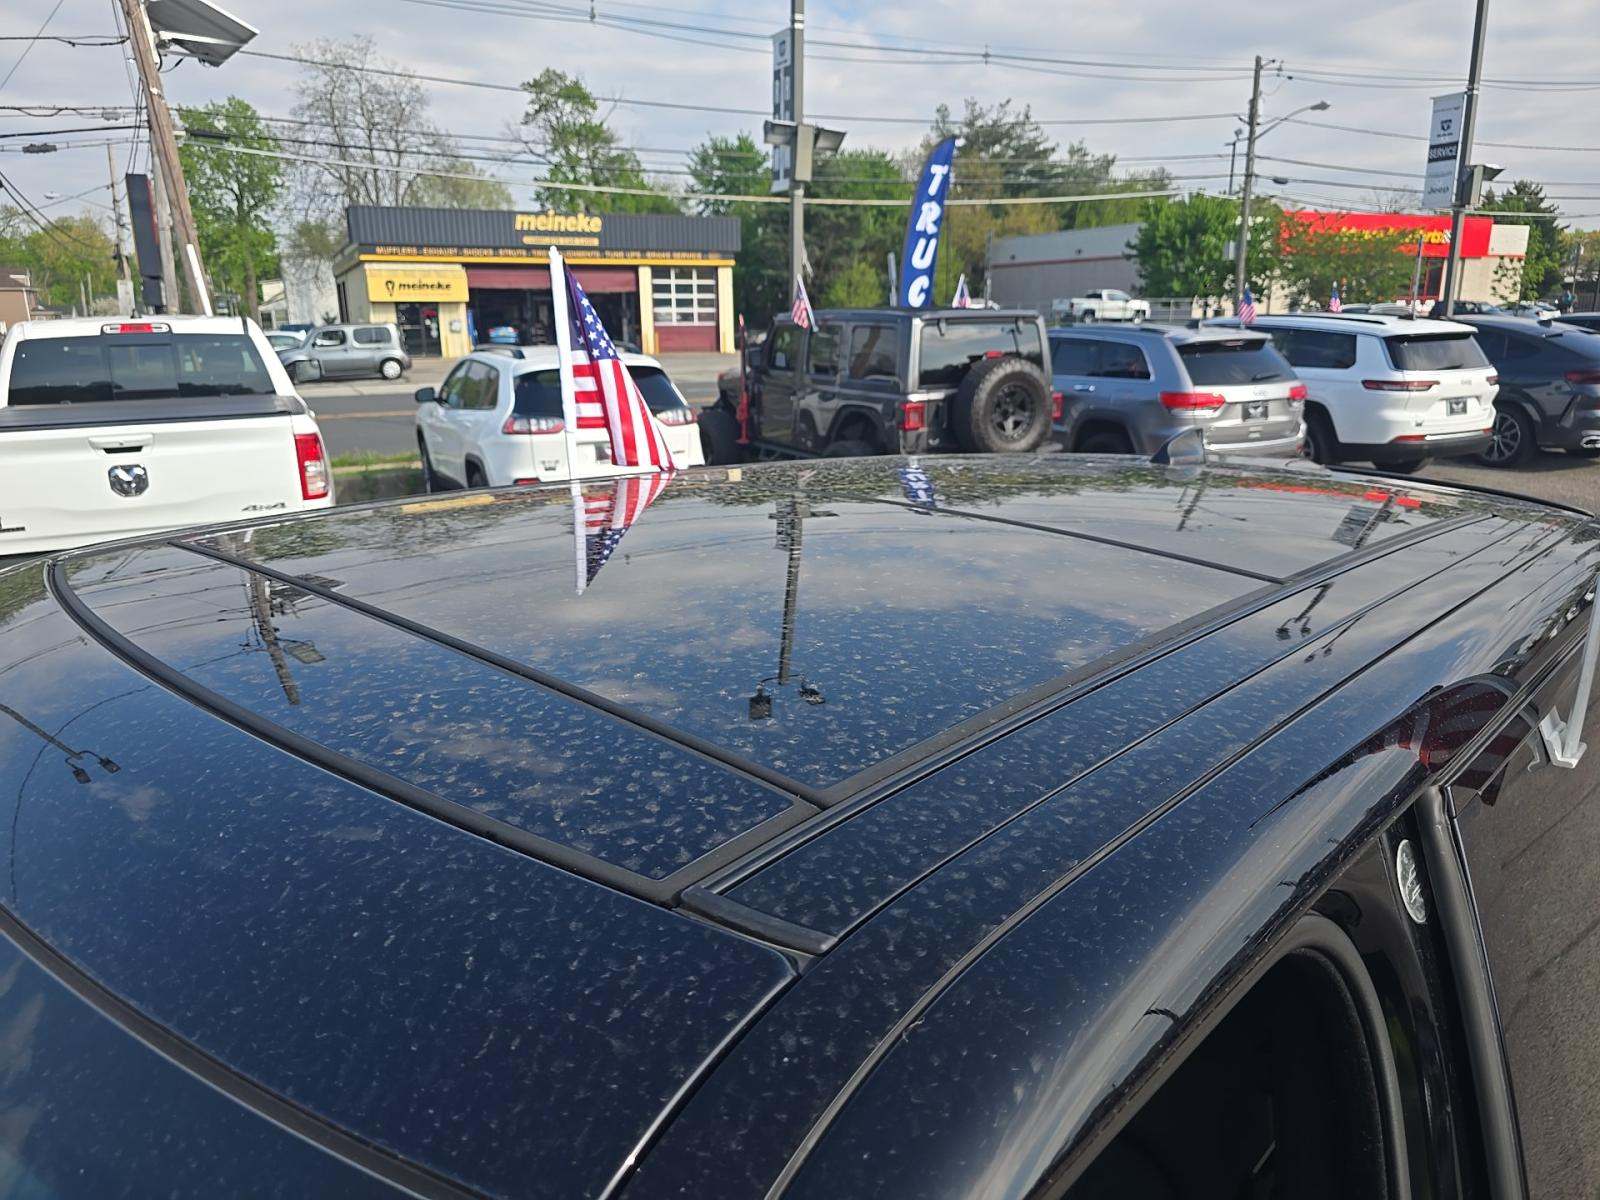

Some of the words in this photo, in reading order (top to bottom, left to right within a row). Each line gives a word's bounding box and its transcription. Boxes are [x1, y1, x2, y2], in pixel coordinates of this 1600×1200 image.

[1429, 145, 1457, 160] SERVICE
[515, 209, 602, 232] meineke
[399, 279, 452, 290] meineke
